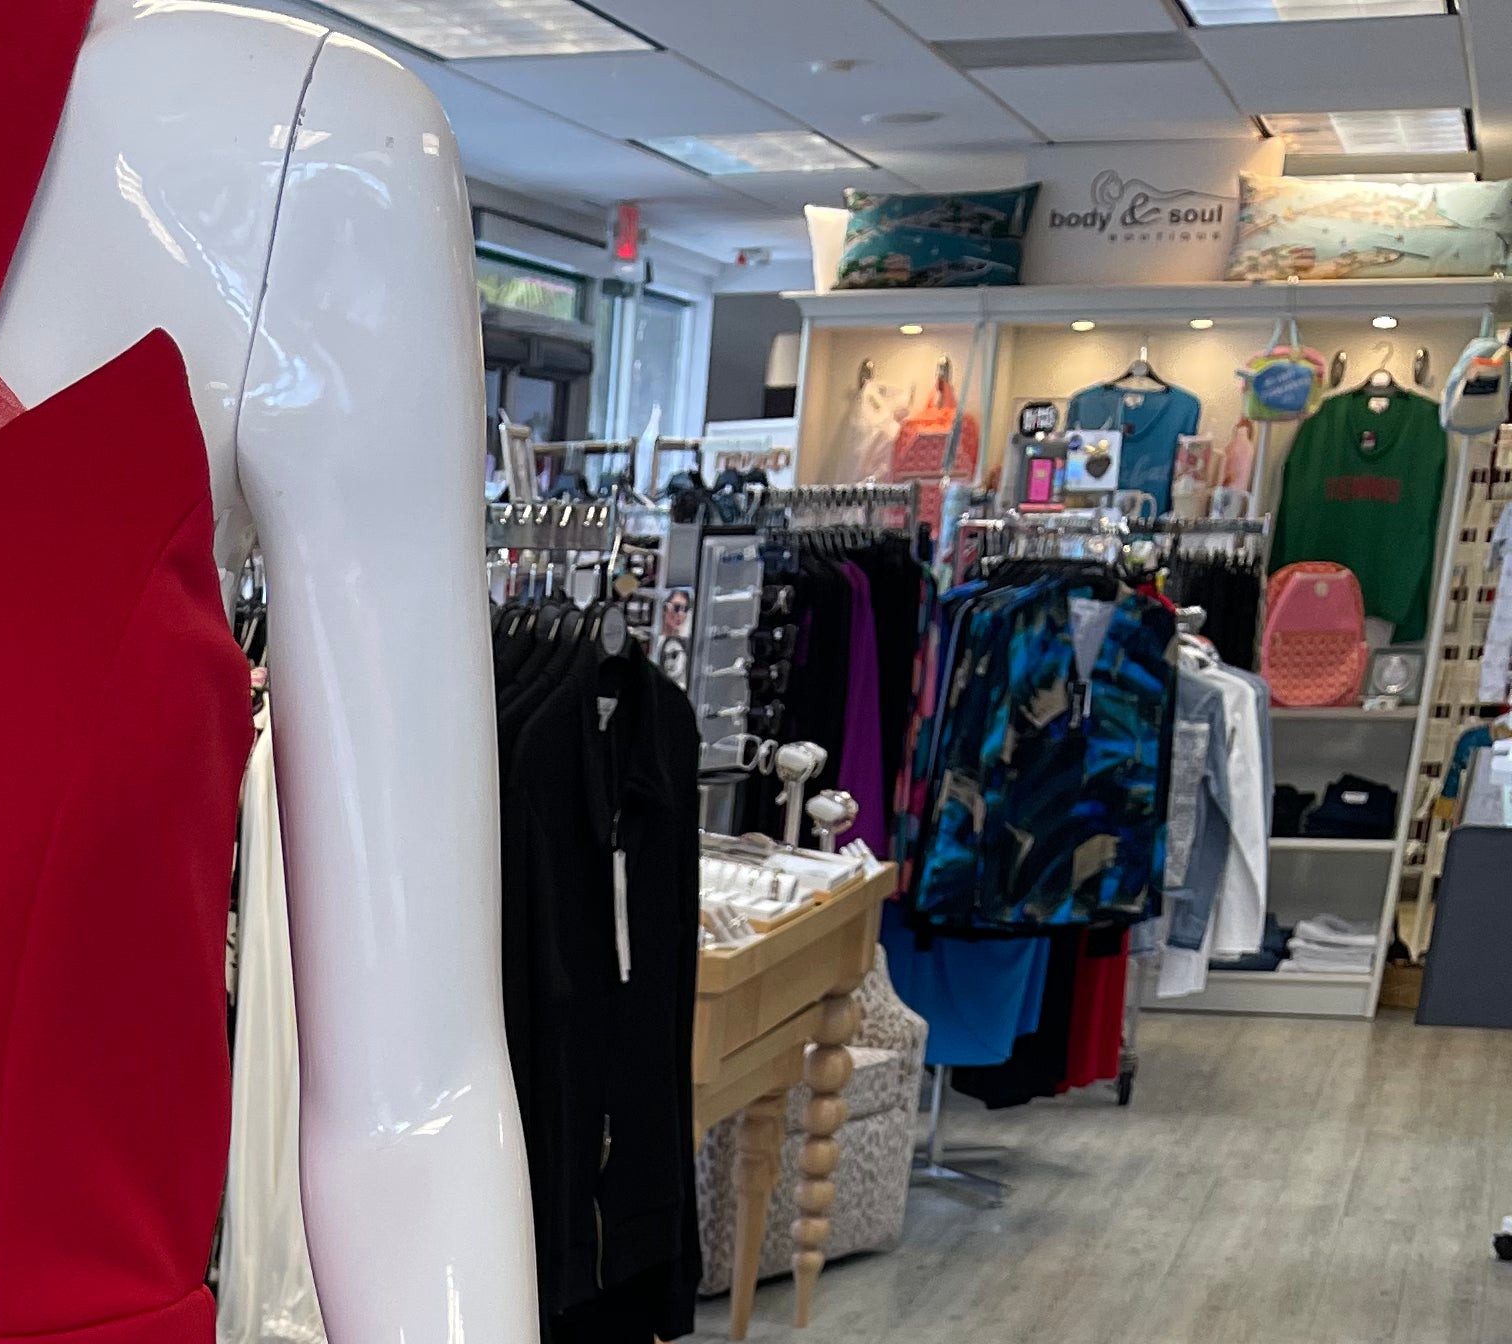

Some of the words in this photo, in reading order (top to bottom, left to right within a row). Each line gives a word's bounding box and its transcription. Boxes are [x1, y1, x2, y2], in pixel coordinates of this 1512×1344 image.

[1049, 208, 1112, 232] body
[1121, 192, 1162, 227] &
[1169, 204, 1223, 224] soul
